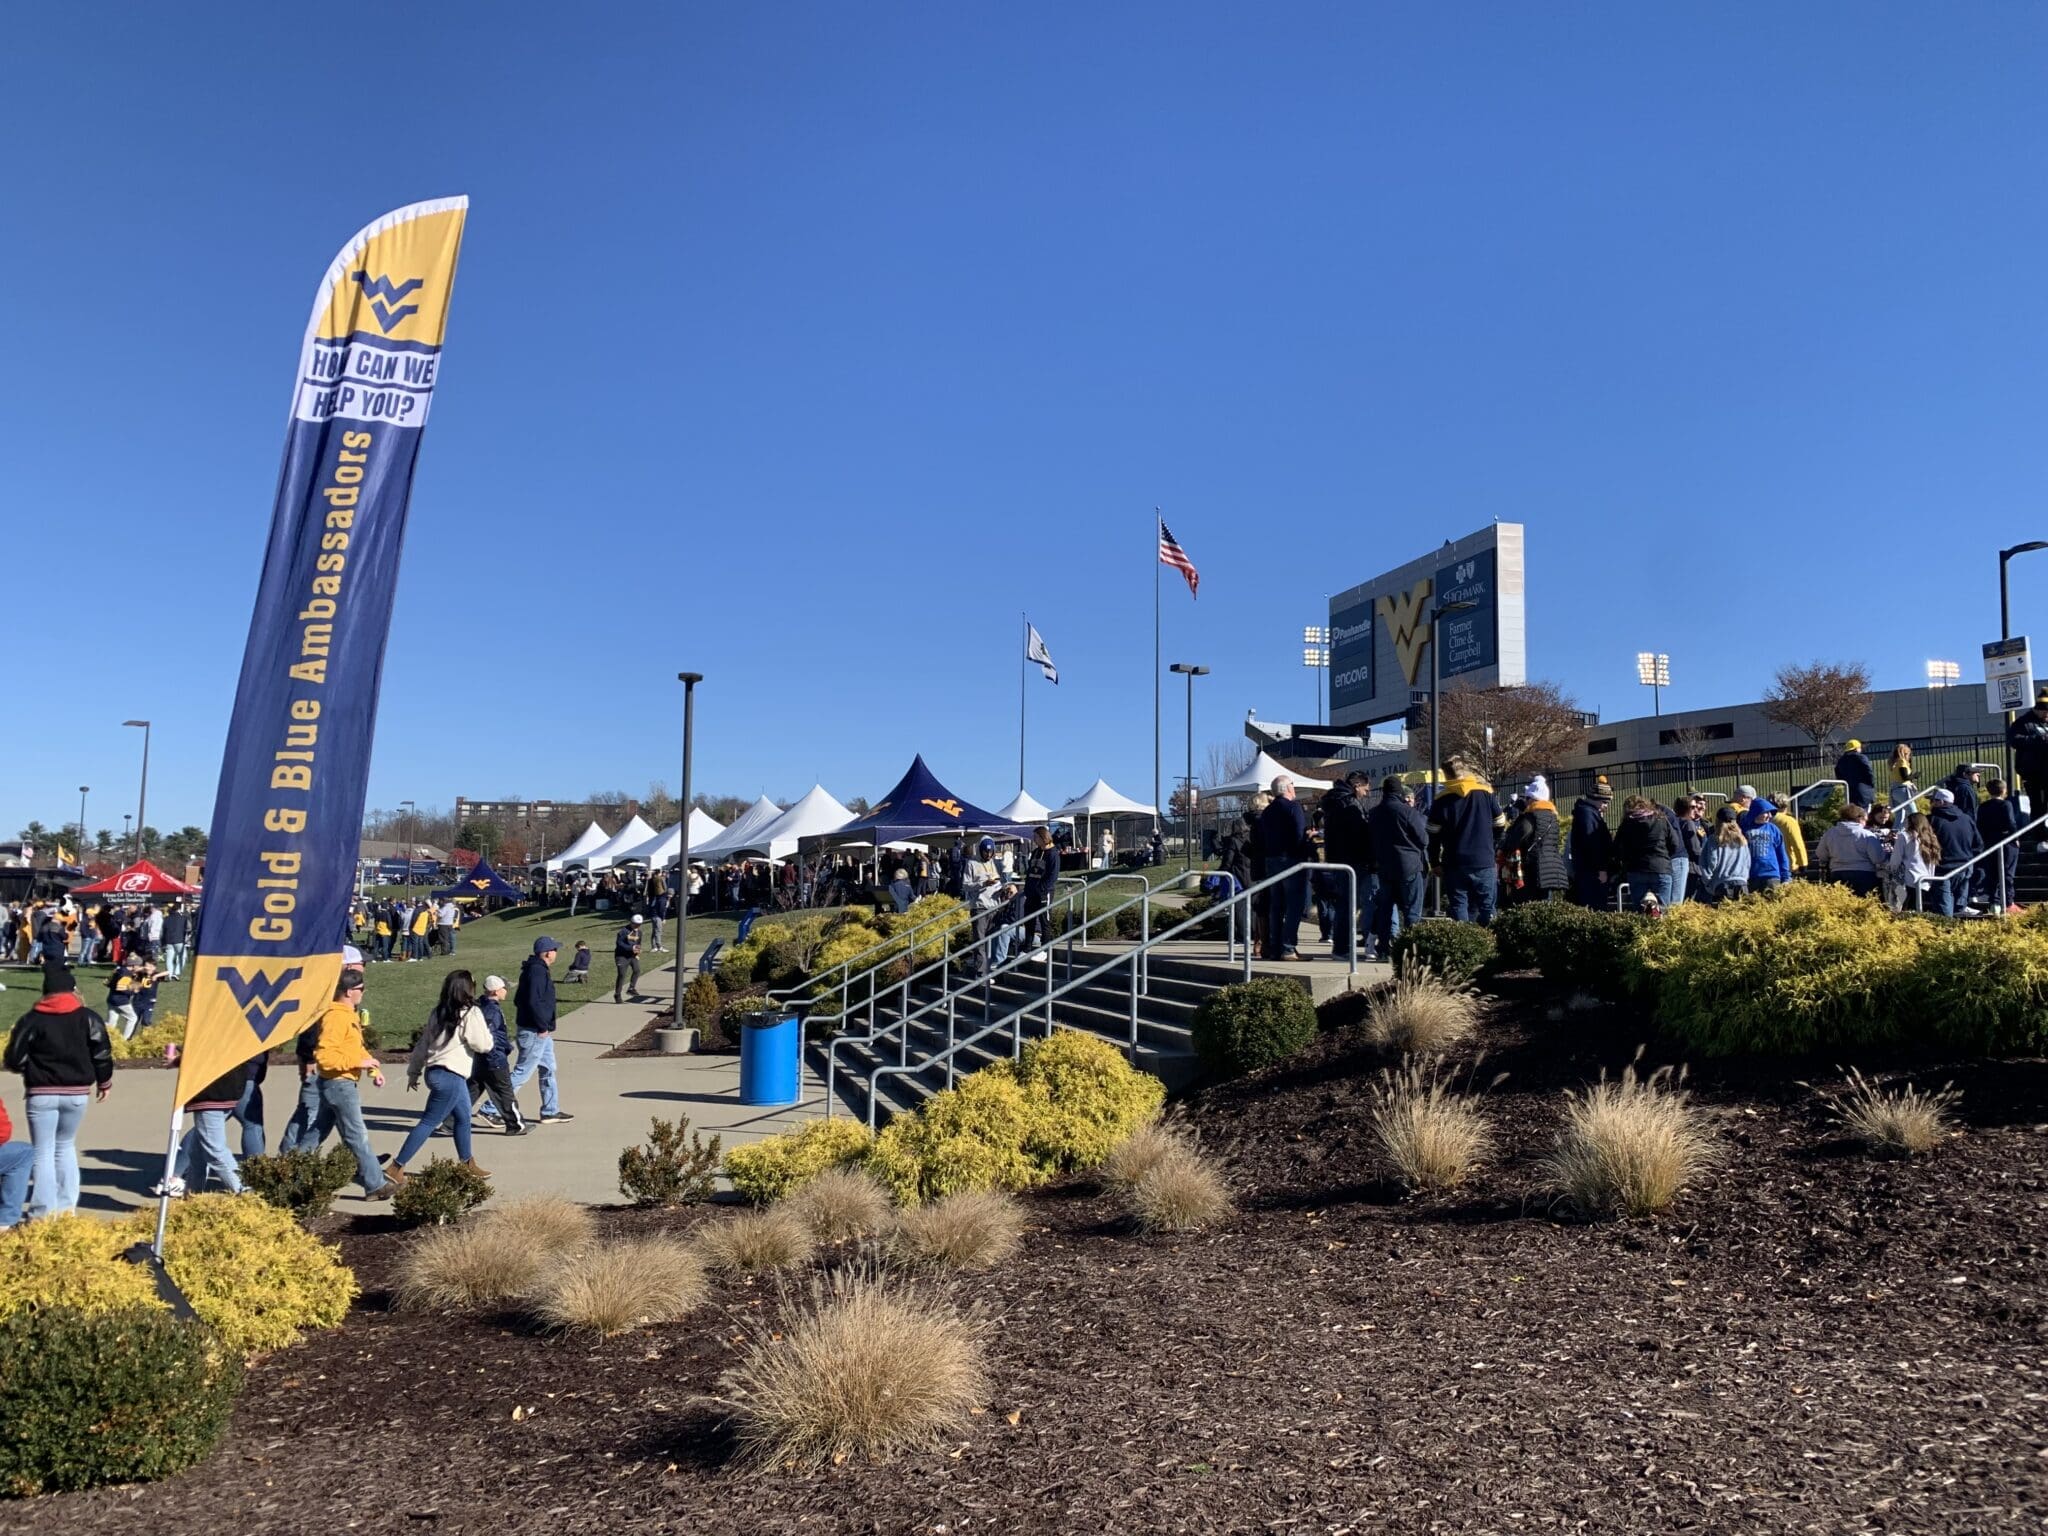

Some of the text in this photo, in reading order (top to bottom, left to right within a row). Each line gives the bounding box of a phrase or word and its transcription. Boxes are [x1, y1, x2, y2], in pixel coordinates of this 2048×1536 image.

[356, 350, 398, 380] CAN
[403, 356, 434, 384] WE
[362, 389, 415, 421] YOU?
[1449, 620, 1473, 635] Farmer
[1449, 641, 1481, 663] Campbell
[249, 431, 372, 942] Gold & Blue Ambassadors
[1335, 665, 1368, 688] encova
